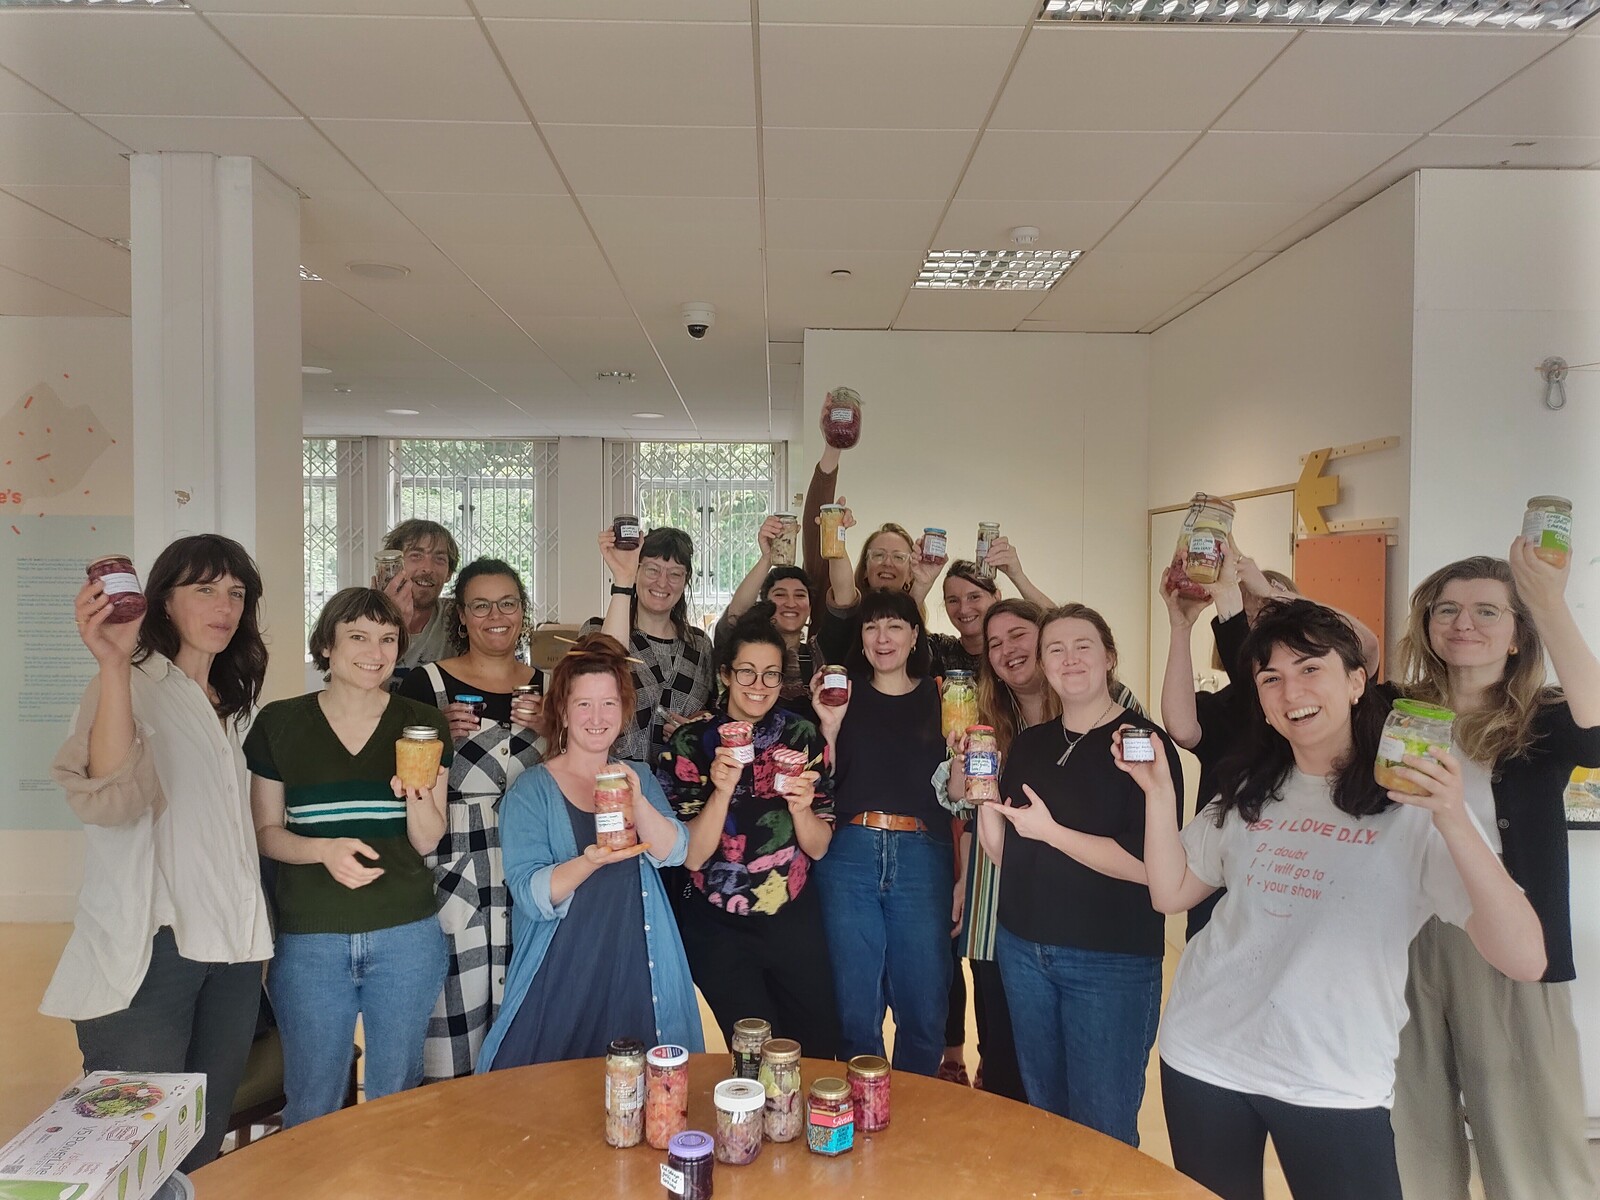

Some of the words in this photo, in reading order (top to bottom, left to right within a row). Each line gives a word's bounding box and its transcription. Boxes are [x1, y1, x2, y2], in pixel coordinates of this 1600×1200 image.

[1279, 820, 1287, 831] I
[1288, 818, 1337, 837] LOVE
[1337, 827, 1379, 845] D.I.Y.
[1256, 842, 1267, 853] D
[1273, 846, 1308, 861] doubt
[1249, 857, 1257, 869] I
[1274, 862, 1295, 876] will
[1293, 867, 1310, 880] go
[1312, 868, 1325, 881] to
[1246, 874, 1255, 887] Y
[1262, 880, 1289, 893] your
[1290, 883, 1322, 900] show
